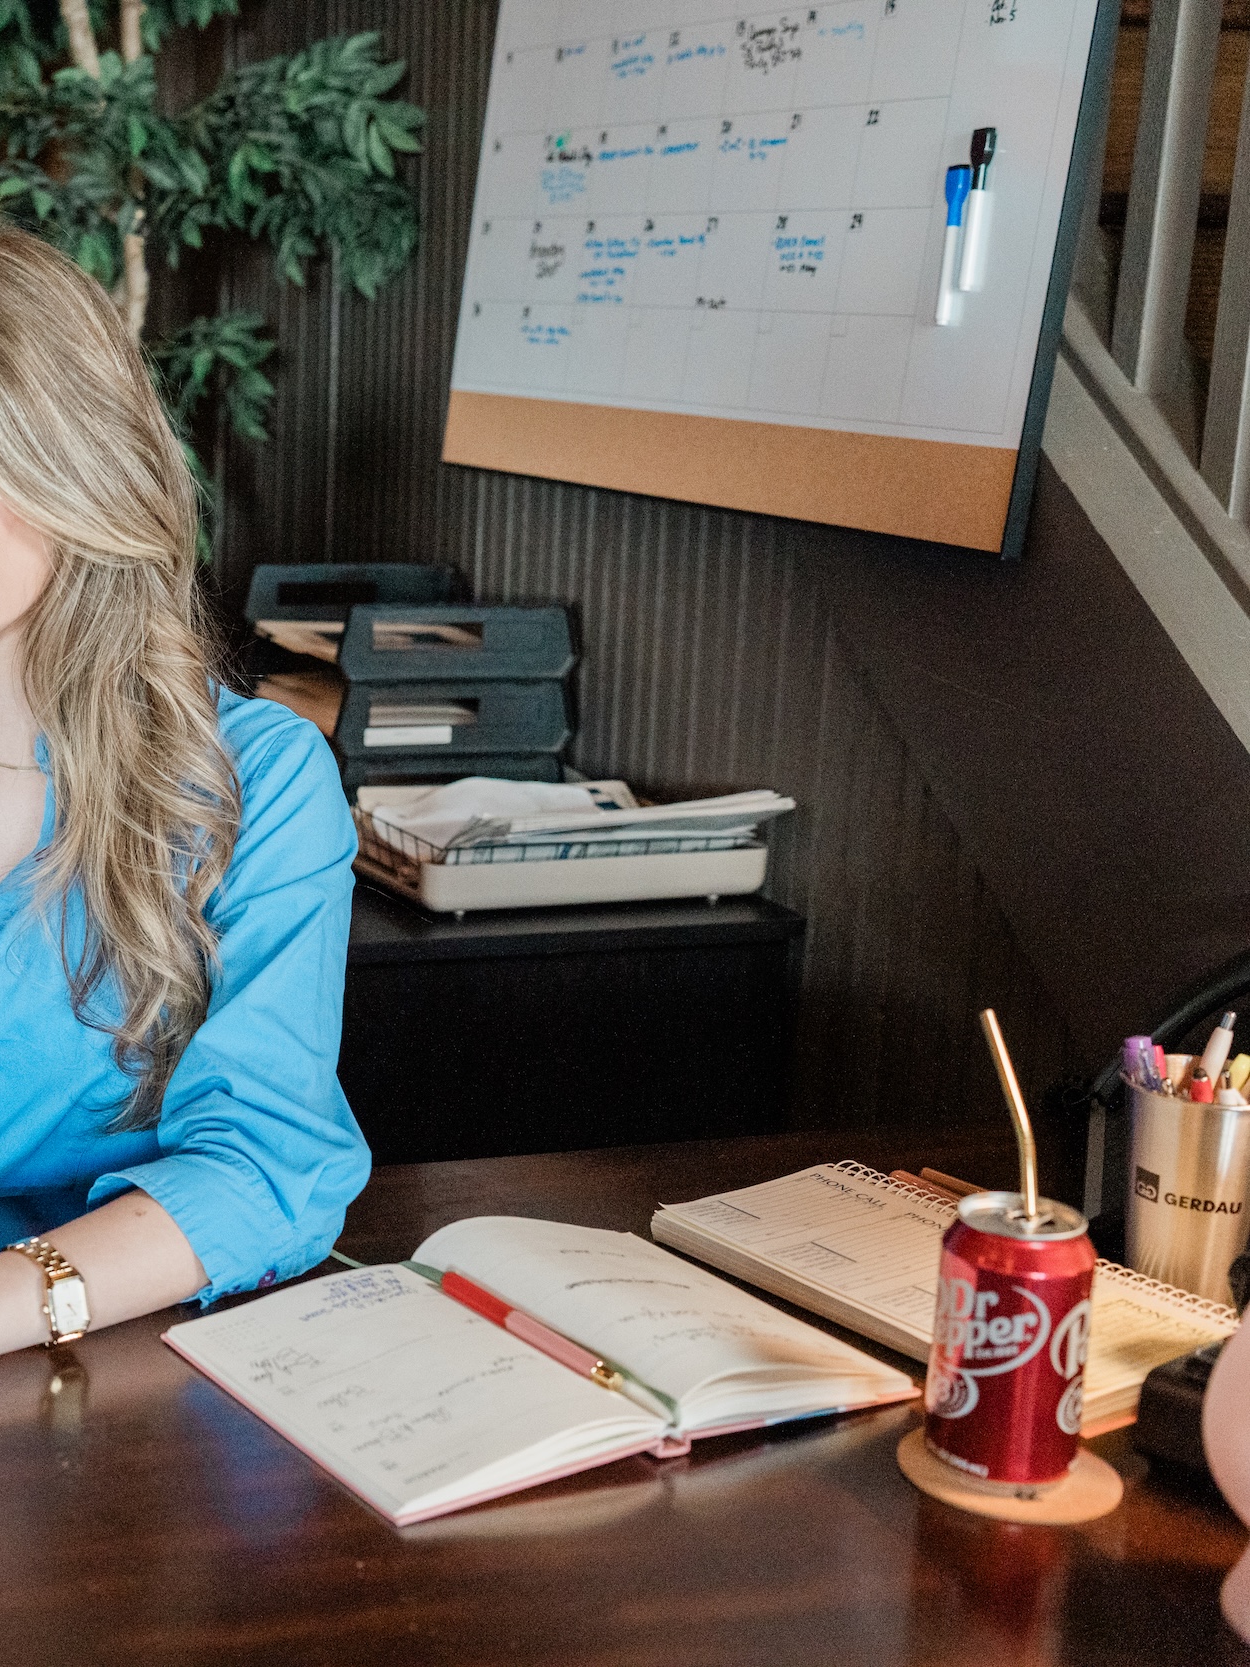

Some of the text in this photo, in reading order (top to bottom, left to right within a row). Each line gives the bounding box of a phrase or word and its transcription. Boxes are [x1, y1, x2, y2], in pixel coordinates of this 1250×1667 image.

[809, 1172, 888, 1208] PHONE CALL
[1164, 1192, 1243, 1215] GERDAU
[904, 1211, 948, 1232] PHON
[946, 1279, 1000, 1319] Dr
